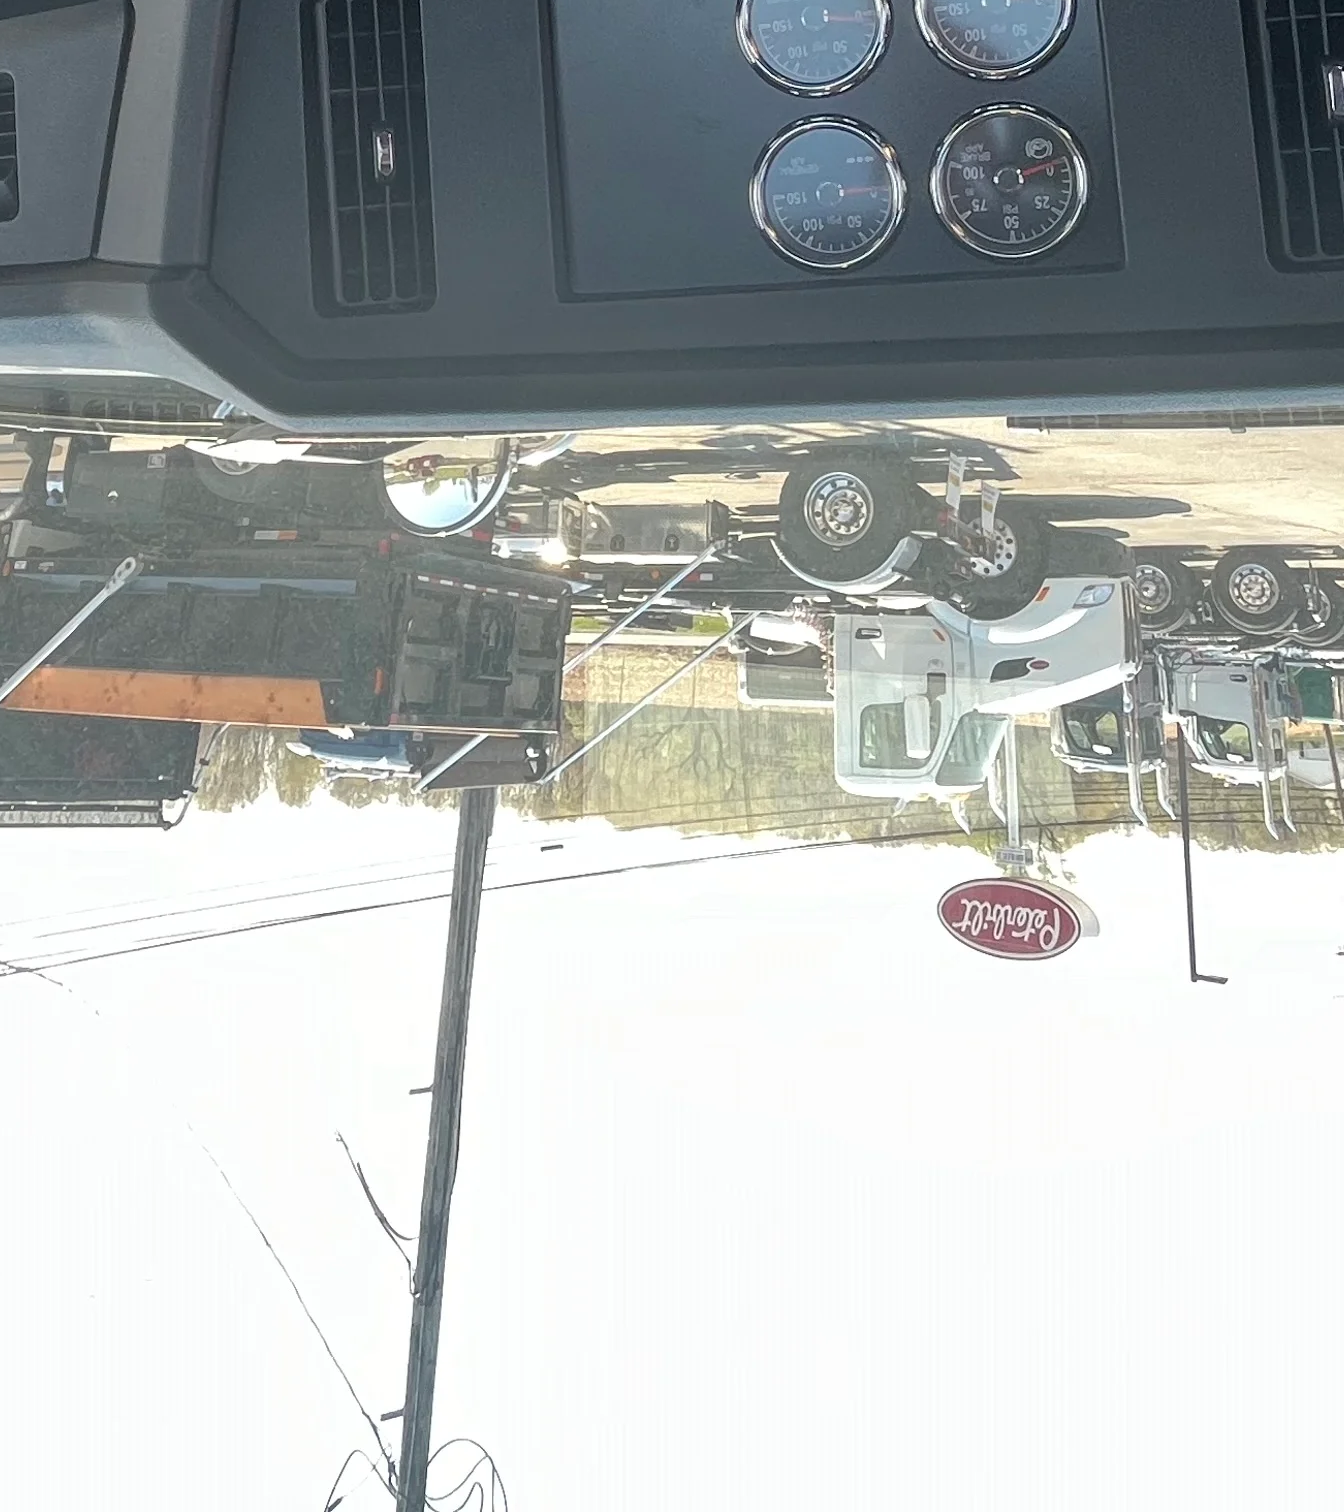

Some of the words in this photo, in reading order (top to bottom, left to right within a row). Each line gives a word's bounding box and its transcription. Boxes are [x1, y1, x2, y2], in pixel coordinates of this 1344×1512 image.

[948, 2, 970, 16] 150
[772, 19, 793, 32] 150
[1012, 24, 1027, 36] 50
[965, 28, 986, 42] 100
[788, 45, 807, 58] 100
[833, 40, 848, 53] 50
[963, 166, 985, 180] 100
[787, 192, 807, 205] 150
[971, 199, 987, 211] 75
[1034, 195, 1050, 209] 25
[1002, 204, 1018, 214] PSI
[803, 218, 824, 231] 100
[827, 215, 842, 224] PSI
[847, 215, 862, 228] 50
[1004, 216, 1019, 229] 50
[952, 899, 1060, 951] Peterbilt
